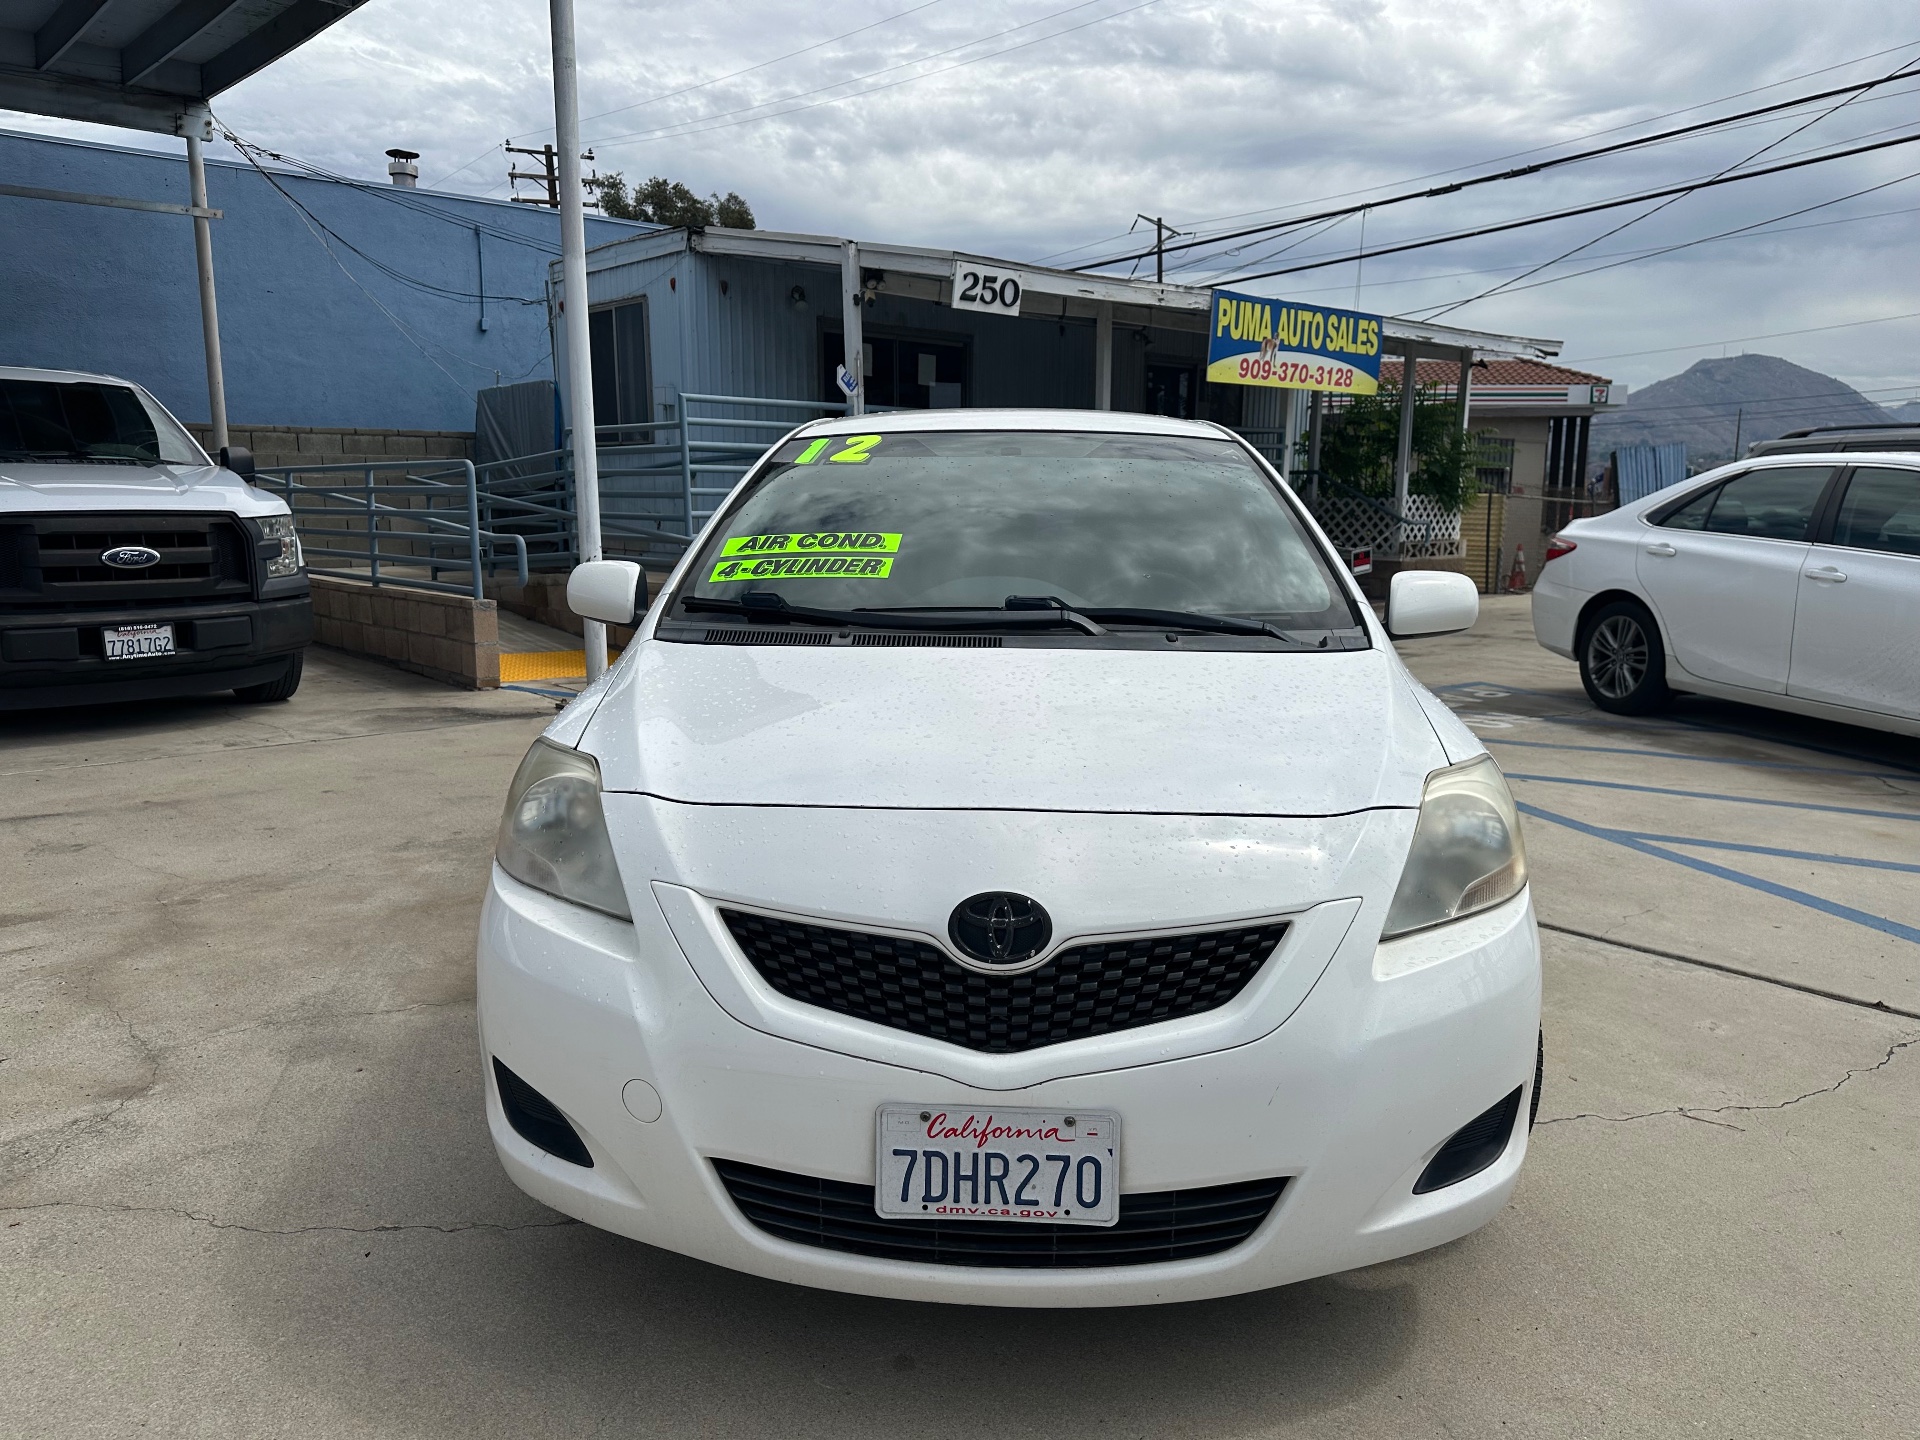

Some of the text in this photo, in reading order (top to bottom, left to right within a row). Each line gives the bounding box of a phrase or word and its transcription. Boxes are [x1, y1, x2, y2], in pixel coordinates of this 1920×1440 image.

[959, 271, 1020, 308] 250
[1216, 298, 1379, 357] PUMA AUTO SALES
[1238, 357, 1354, 388] 909-370-3128
[794, 434, 882, 465] 12
[116, 550, 148, 564] Ford
[736, 533, 887, 552] AIR COND.
[717, 557, 887, 578] 4-CYLINDER
[107, 636, 172, 656] 77817G2
[926, 1112, 1076, 1149] California
[892, 1148, 1102, 1209] 7DHR270
[935, 1205, 1058, 1218] dmv.ca.gov
